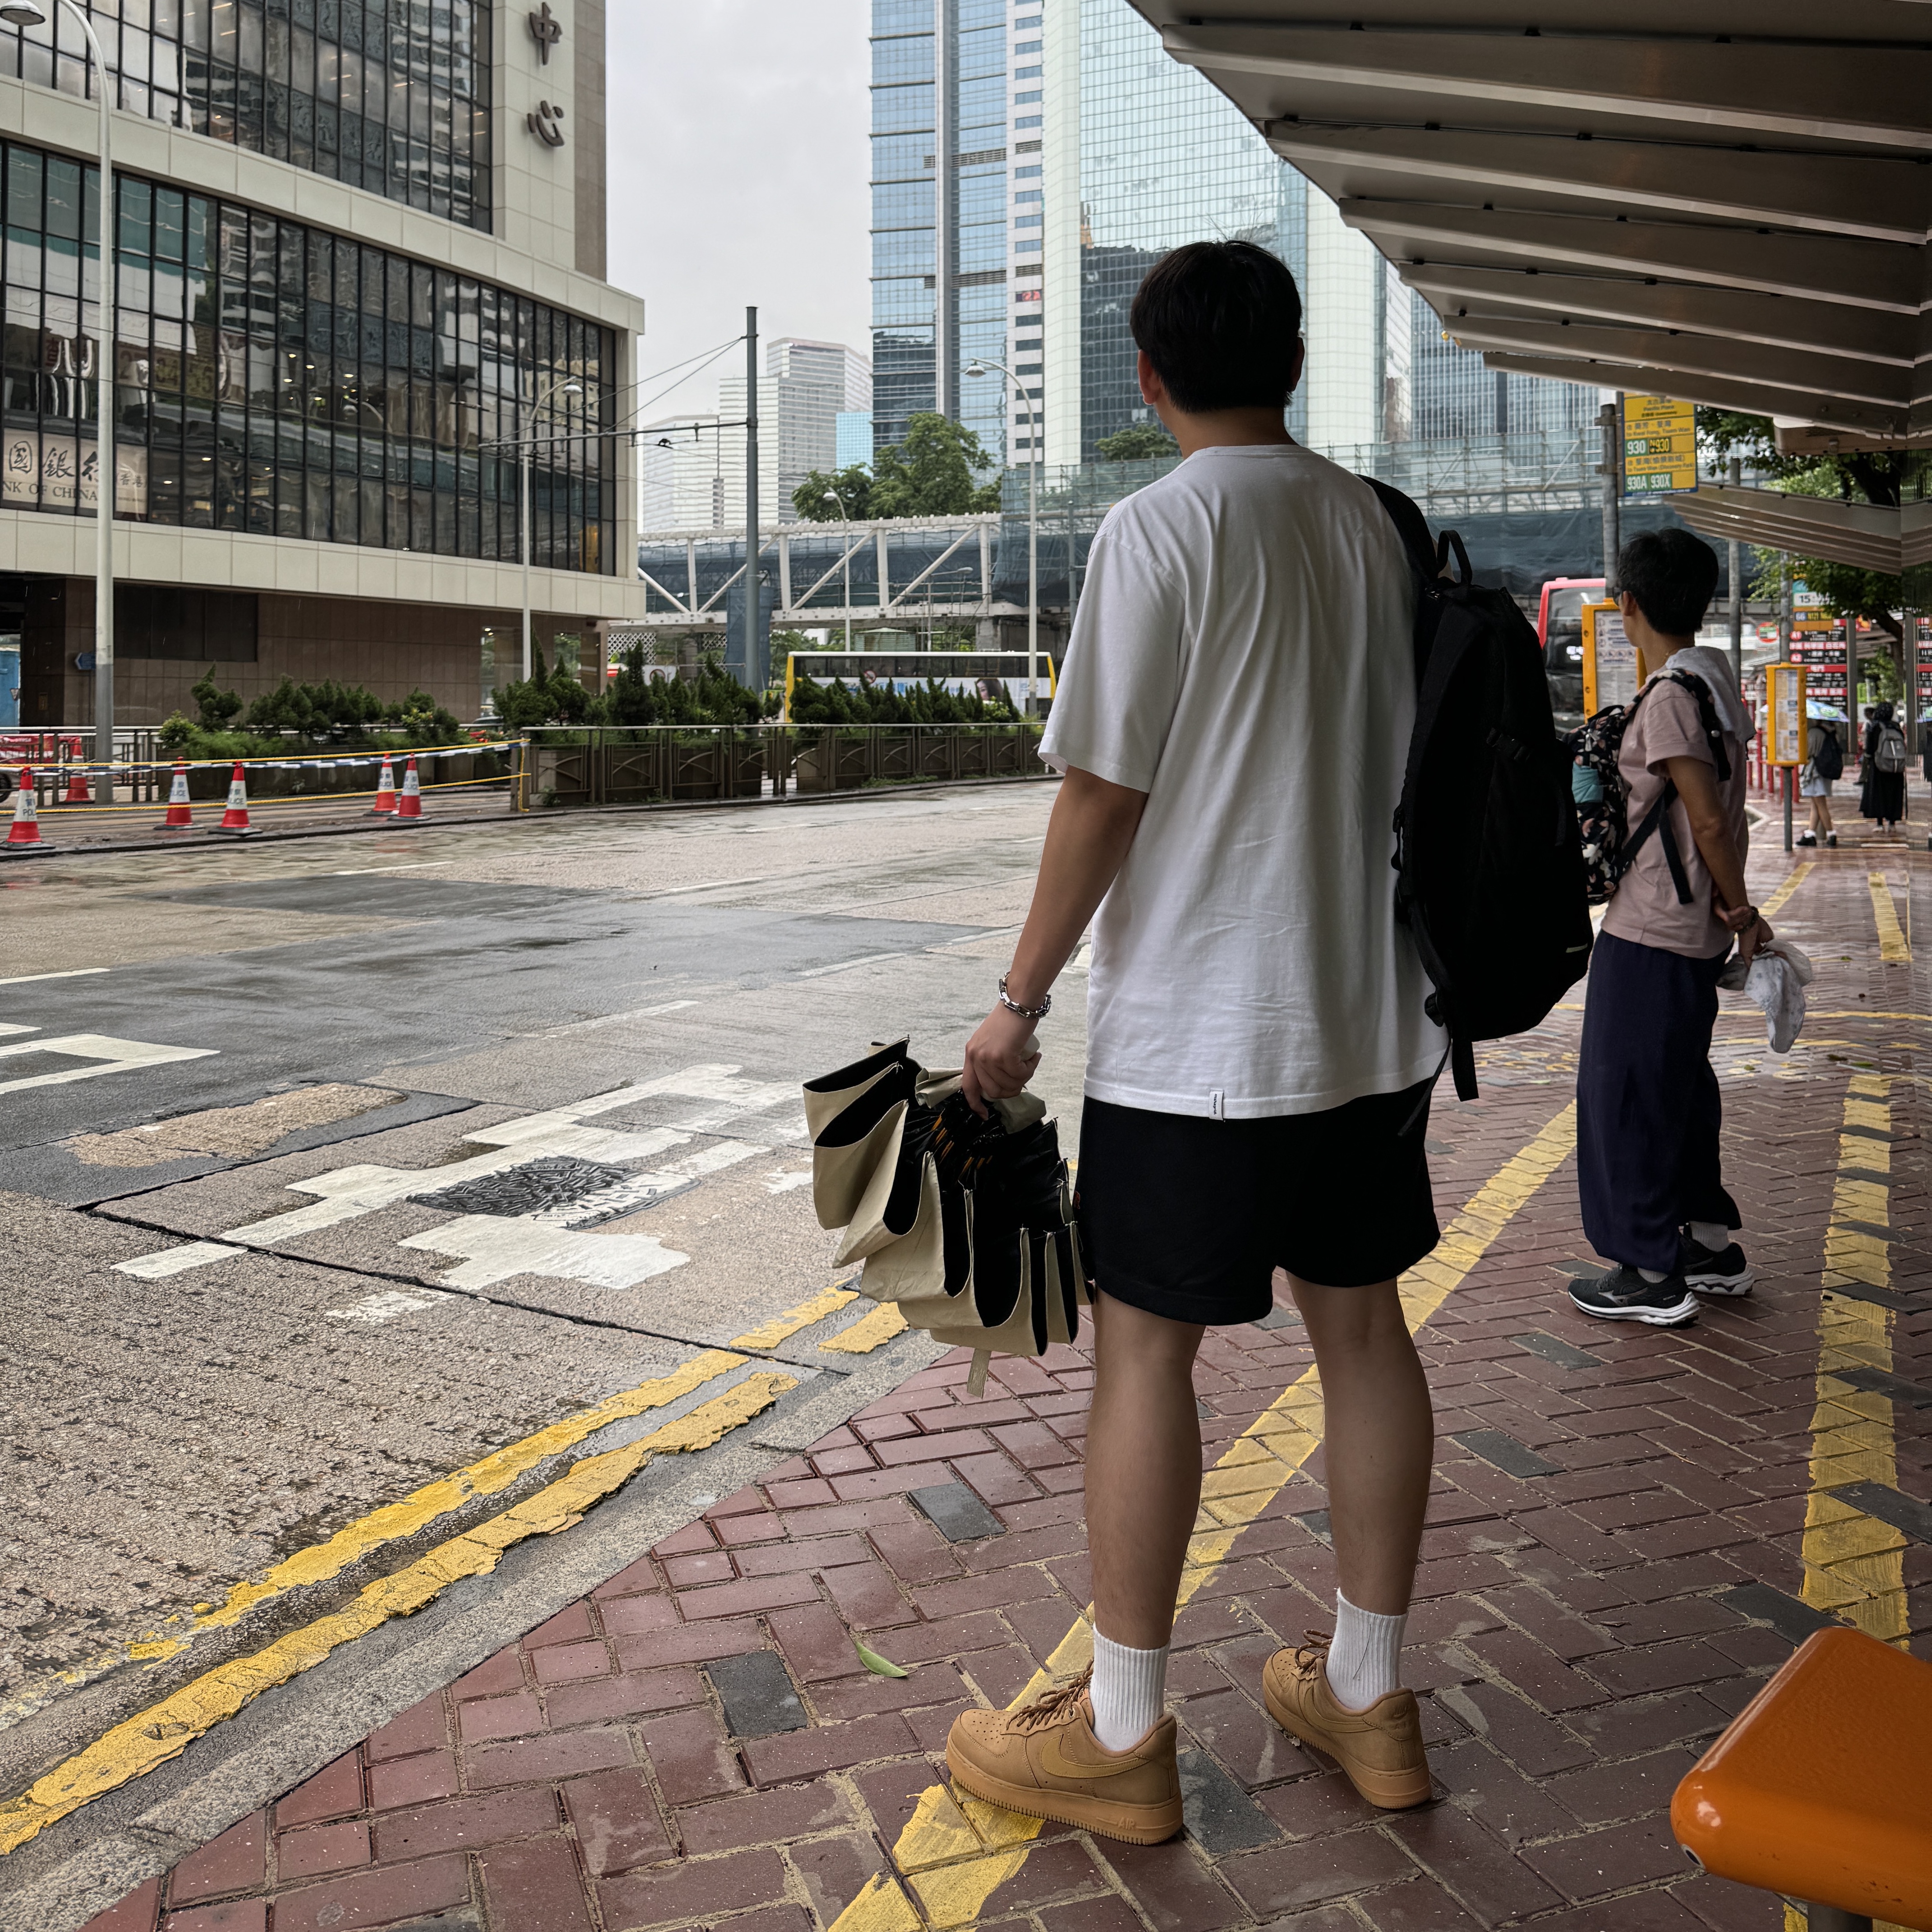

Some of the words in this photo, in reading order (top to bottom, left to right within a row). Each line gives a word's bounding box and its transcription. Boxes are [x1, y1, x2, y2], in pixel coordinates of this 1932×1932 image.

[527, 2, 564, 147] 中心
[1627, 440, 1646, 455] 930
[1649, 438, 1669, 453] N930
[1627, 475, 1647, 490] 930A
[1651, 474, 1670, 488] 930X
[1117, 1817, 1135, 1831] AIR
